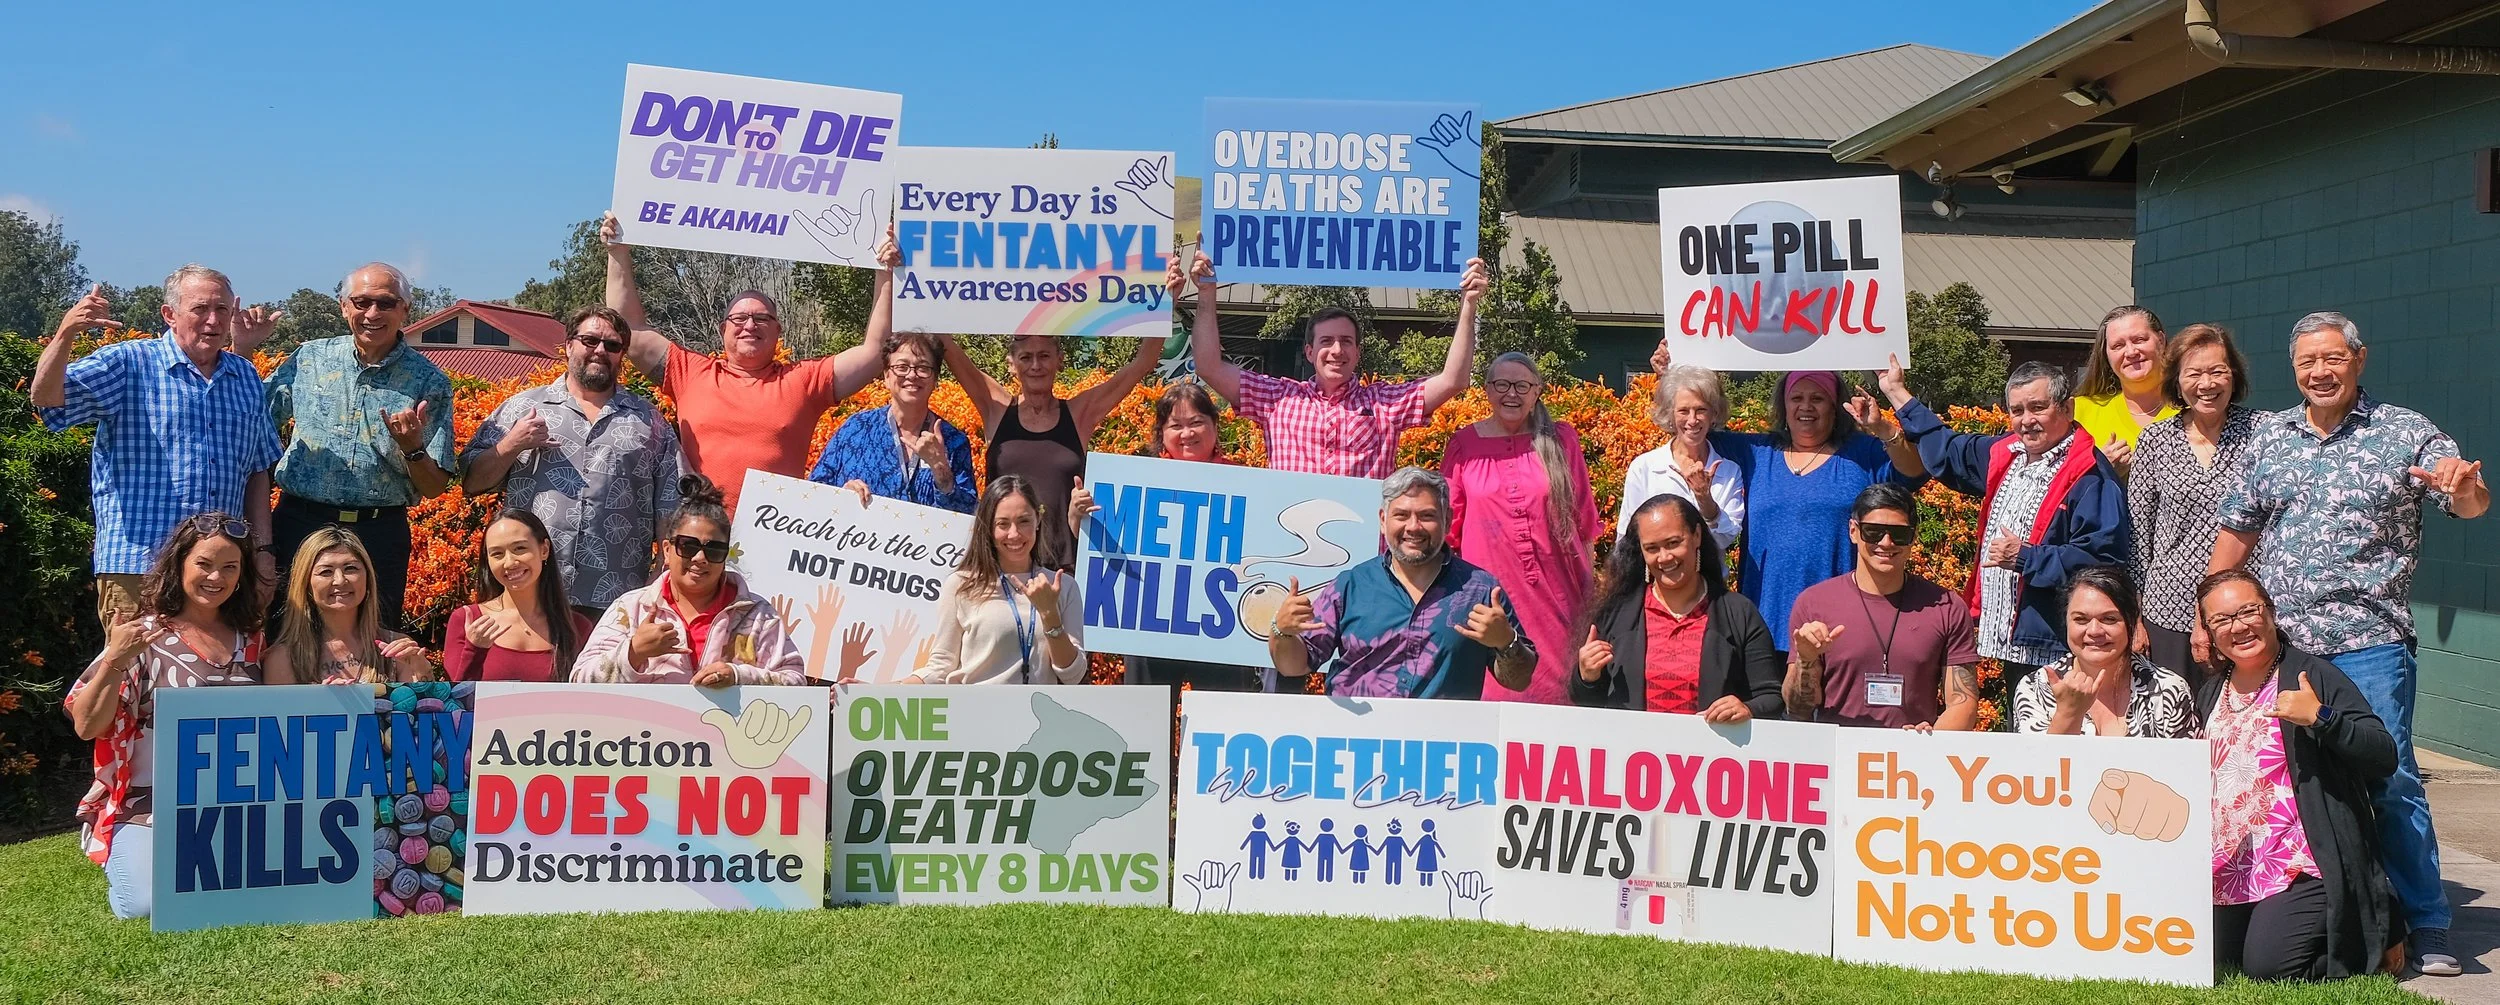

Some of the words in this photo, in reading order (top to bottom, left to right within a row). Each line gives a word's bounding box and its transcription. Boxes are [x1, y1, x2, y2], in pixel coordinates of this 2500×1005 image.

[744, 131, 776, 150] TO
[799, 111, 893, 162] DIE
[1214, 130, 1412, 172] OVERDOSE
[649, 141, 736, 184] GET
[736, 152, 847, 196] HIGH
[1213, 172, 1362, 213] DEATHS
[1373, 178, 1451, 215] ARE
[639, 201, 675, 225] BE
[678, 206, 790, 236] AKAMAI
[900, 183, 1001, 217] Every
[1011, 185, 1081, 220] Day
[1091, 186, 1117, 214] is
[899, 220, 1167, 271] FENTANYL
[1214, 215, 1461, 274] PREVENTABLE
[1679, 222, 1759, 275] ONE
[1772, 218, 1879, 273] PILL
[897, 272, 1088, 303] Awareness
[1098, 276, 1165, 312] Day
[1680, 280, 1761, 340] CAN
[1783, 278, 1886, 336] KILL
[755, 505, 837, 541] Reach
[837, 522, 883, 555] for
[883, 533, 927, 562] the
[1088, 482, 1246, 565] METH
[787, 549, 844, 581] NOT
[848, 564, 941, 601] DRUGS
[1083, 558, 1239, 639] KILLS
[849, 698, 948, 741] ONE
[176, 713, 472, 805] FENTANY
[478, 729, 711, 767] Addiction
[846, 750, 1150, 797] OVERDOSE
[1192, 732, 1498, 806] TOGETHER
[474, 775, 648, 836] DOES
[677, 776, 810, 836] NOT
[1208, 768, 1308, 802] We
[1353, 774, 1482, 810] Can
[1504, 741, 1829, 825] NALOXONE
[1857, 752, 1934, 810] Eh,
[1947, 755, 2072, 807] You!
[175, 800, 359, 893] KILLS
[845, 799, 1034, 844] DEATH
[472, 843, 803, 884] Discriminate
[845, 854, 989, 893] EVERY
[998, 853, 1026, 894] 8
[1039, 853, 1159, 894] DAYS
[1497, 804, 1642, 880] SAVES
[1687, 819, 1826, 897] LIVES
[1855, 816, 2101, 885] Choose
[1622, 887, 1630, 901] mg
[1856, 881, 1975, 944] Not
[1990, 894, 2057, 948] to
[2074, 892, 2196, 955] Use
